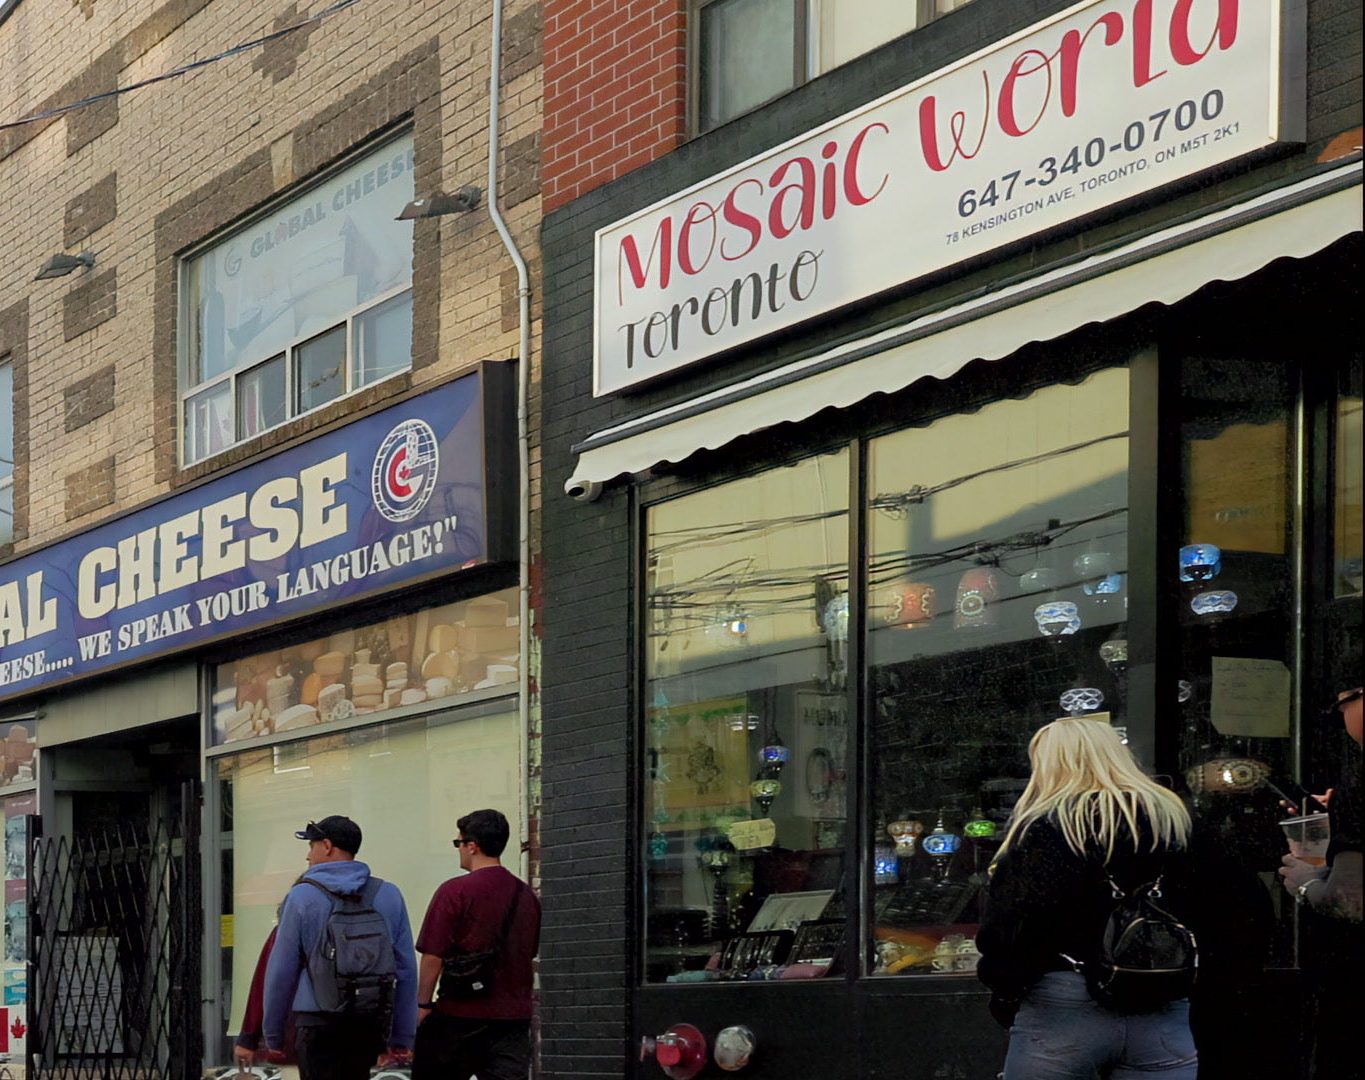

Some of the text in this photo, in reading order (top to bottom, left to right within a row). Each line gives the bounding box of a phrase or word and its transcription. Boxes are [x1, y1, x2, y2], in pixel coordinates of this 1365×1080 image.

[957, 89, 1224, 217] 647-340-0700
[962, 199, 1044, 237] KENSINGTON
[1154, 145, 1176, 164] ON
[1180, 132, 1210, 153] M5T
[1213, 121, 1241, 143] 2K1
[77, 452, 348, 620] CHEESE
[78, 629, 113, 662] WE
[118, 604, 193, 652] SPEAK
[196, 580, 270, 627] YOUR
